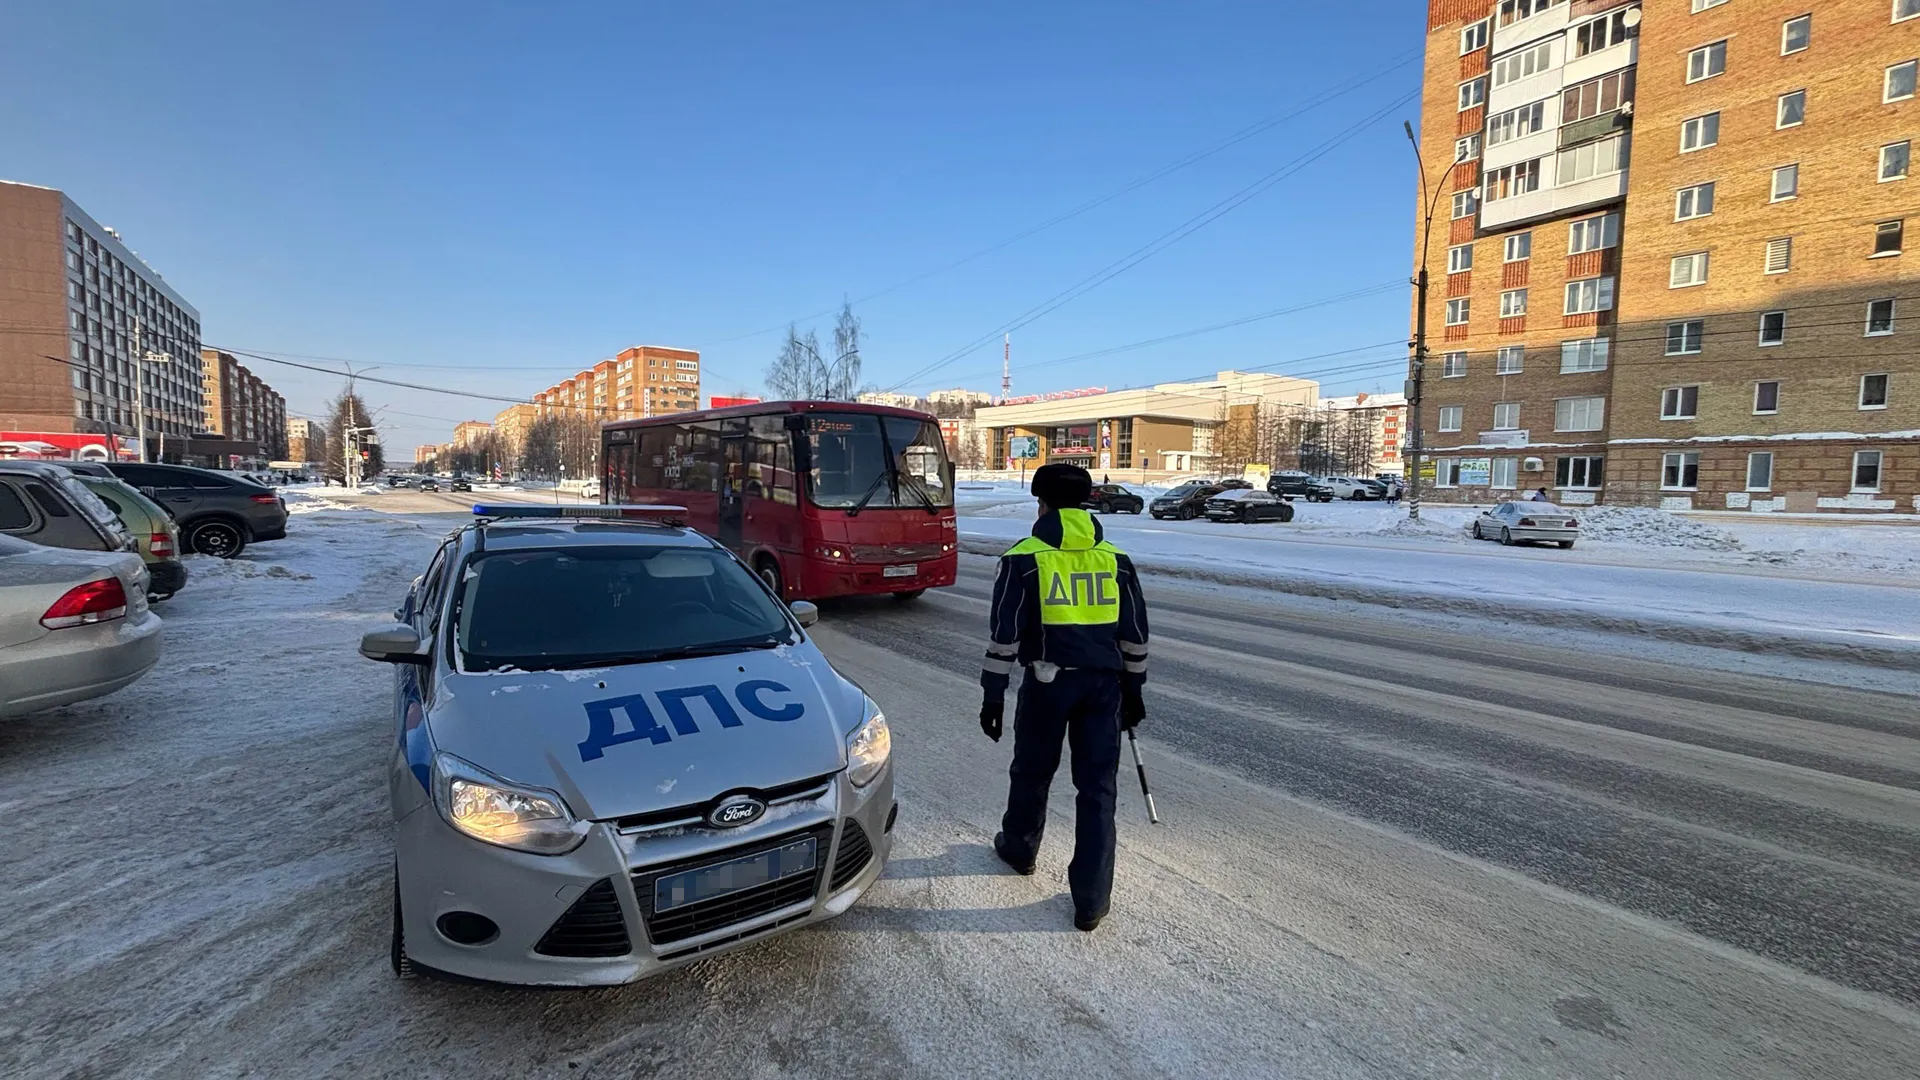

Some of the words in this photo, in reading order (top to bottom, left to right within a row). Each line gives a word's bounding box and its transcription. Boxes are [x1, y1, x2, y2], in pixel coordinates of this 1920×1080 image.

[1044, 572, 1117, 606] ДПС
[577, 679, 805, 762] ДПС
[723, 804, 753, 822] Ford
